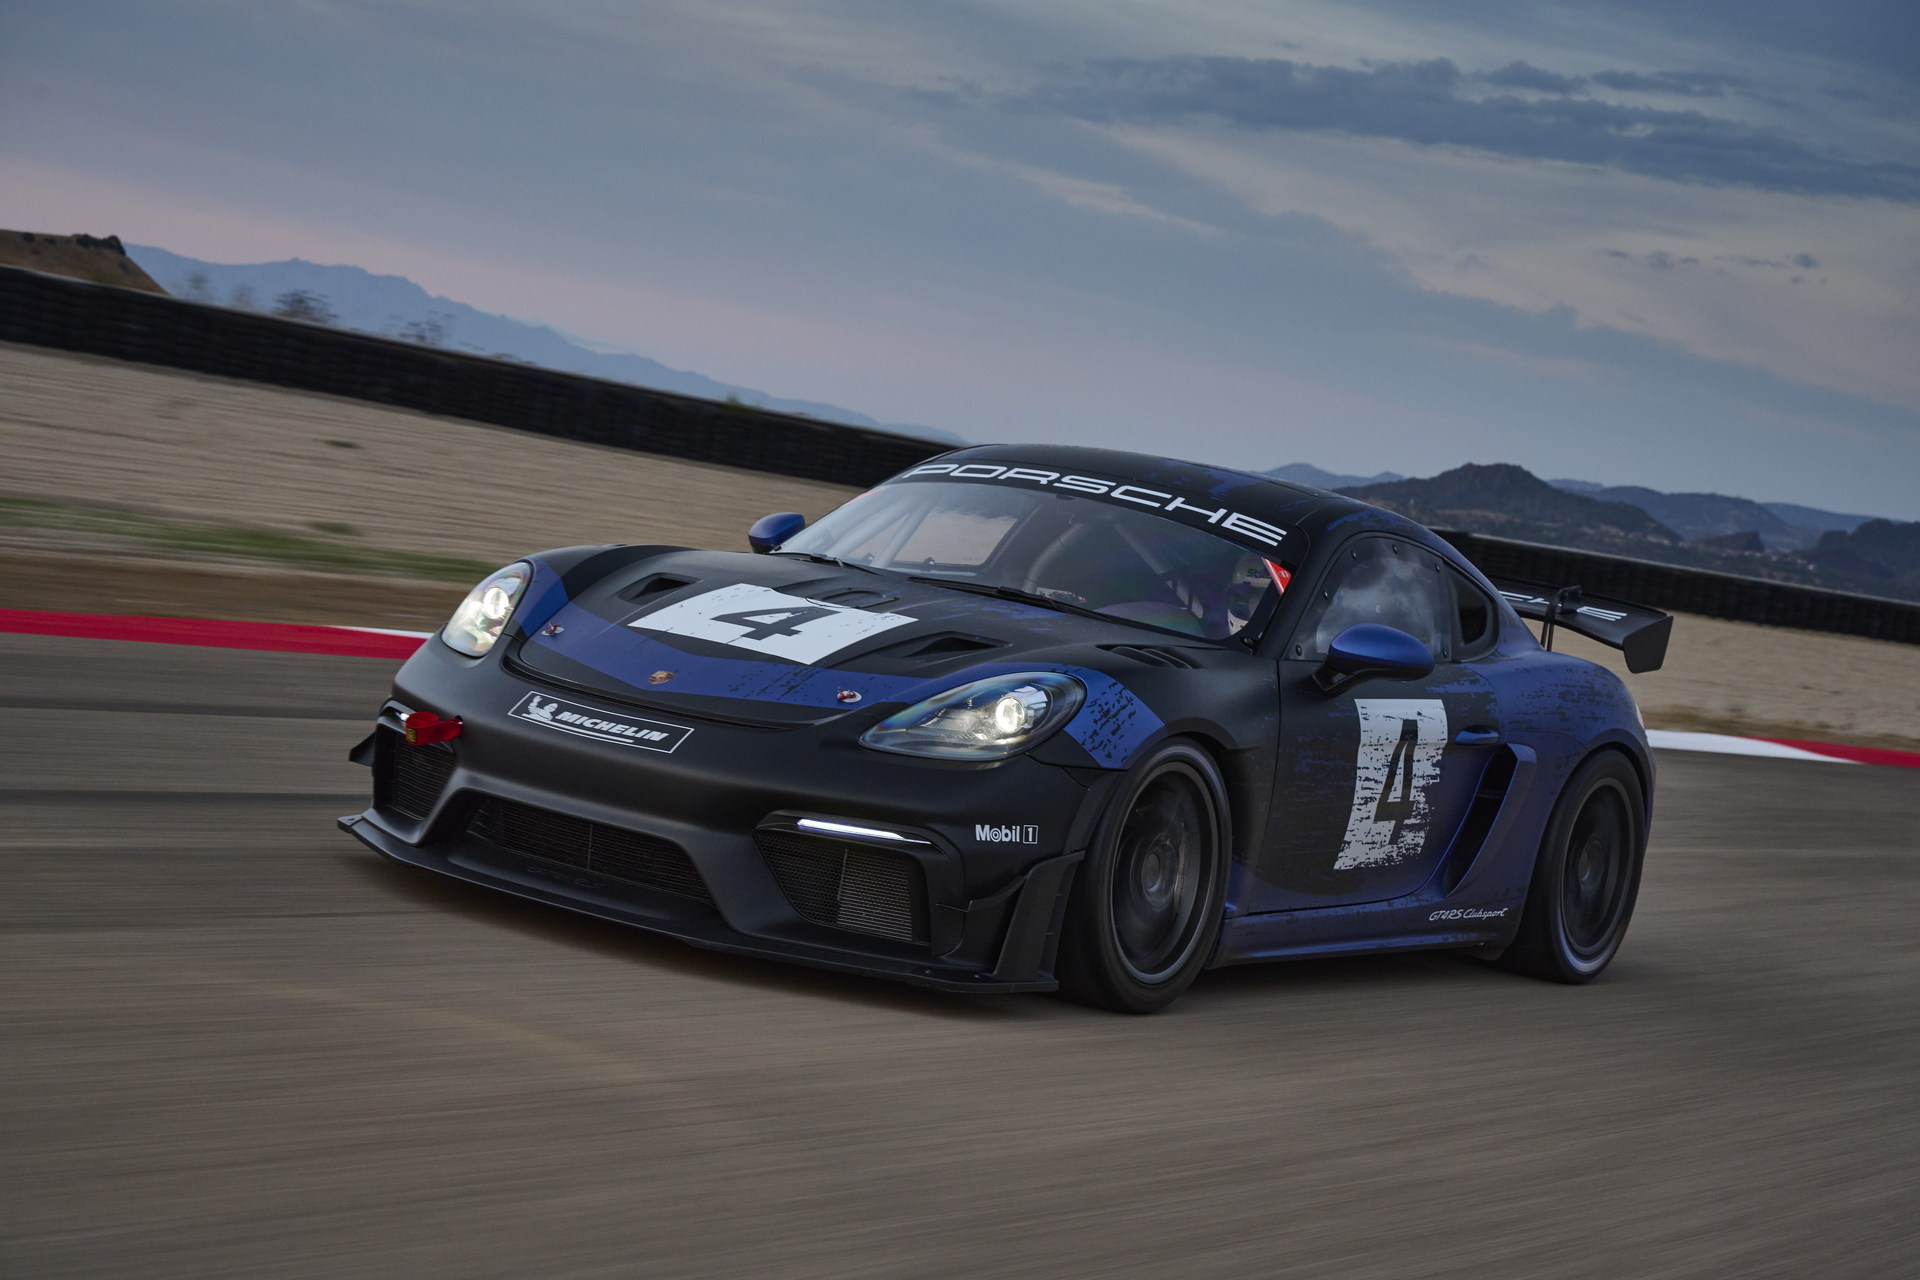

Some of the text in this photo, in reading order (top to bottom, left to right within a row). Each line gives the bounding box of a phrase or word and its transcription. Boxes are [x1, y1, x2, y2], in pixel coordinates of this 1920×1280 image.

[902, 464, 1287, 546] PORSCHE
[710, 607, 842, 640] 4
[555, 711, 669, 741] MICHELIN
[1373, 719, 1419, 846] 4
[975, 824, 1019, 842] Mobil
[1463, 908, 1508, 920] Clubsport
